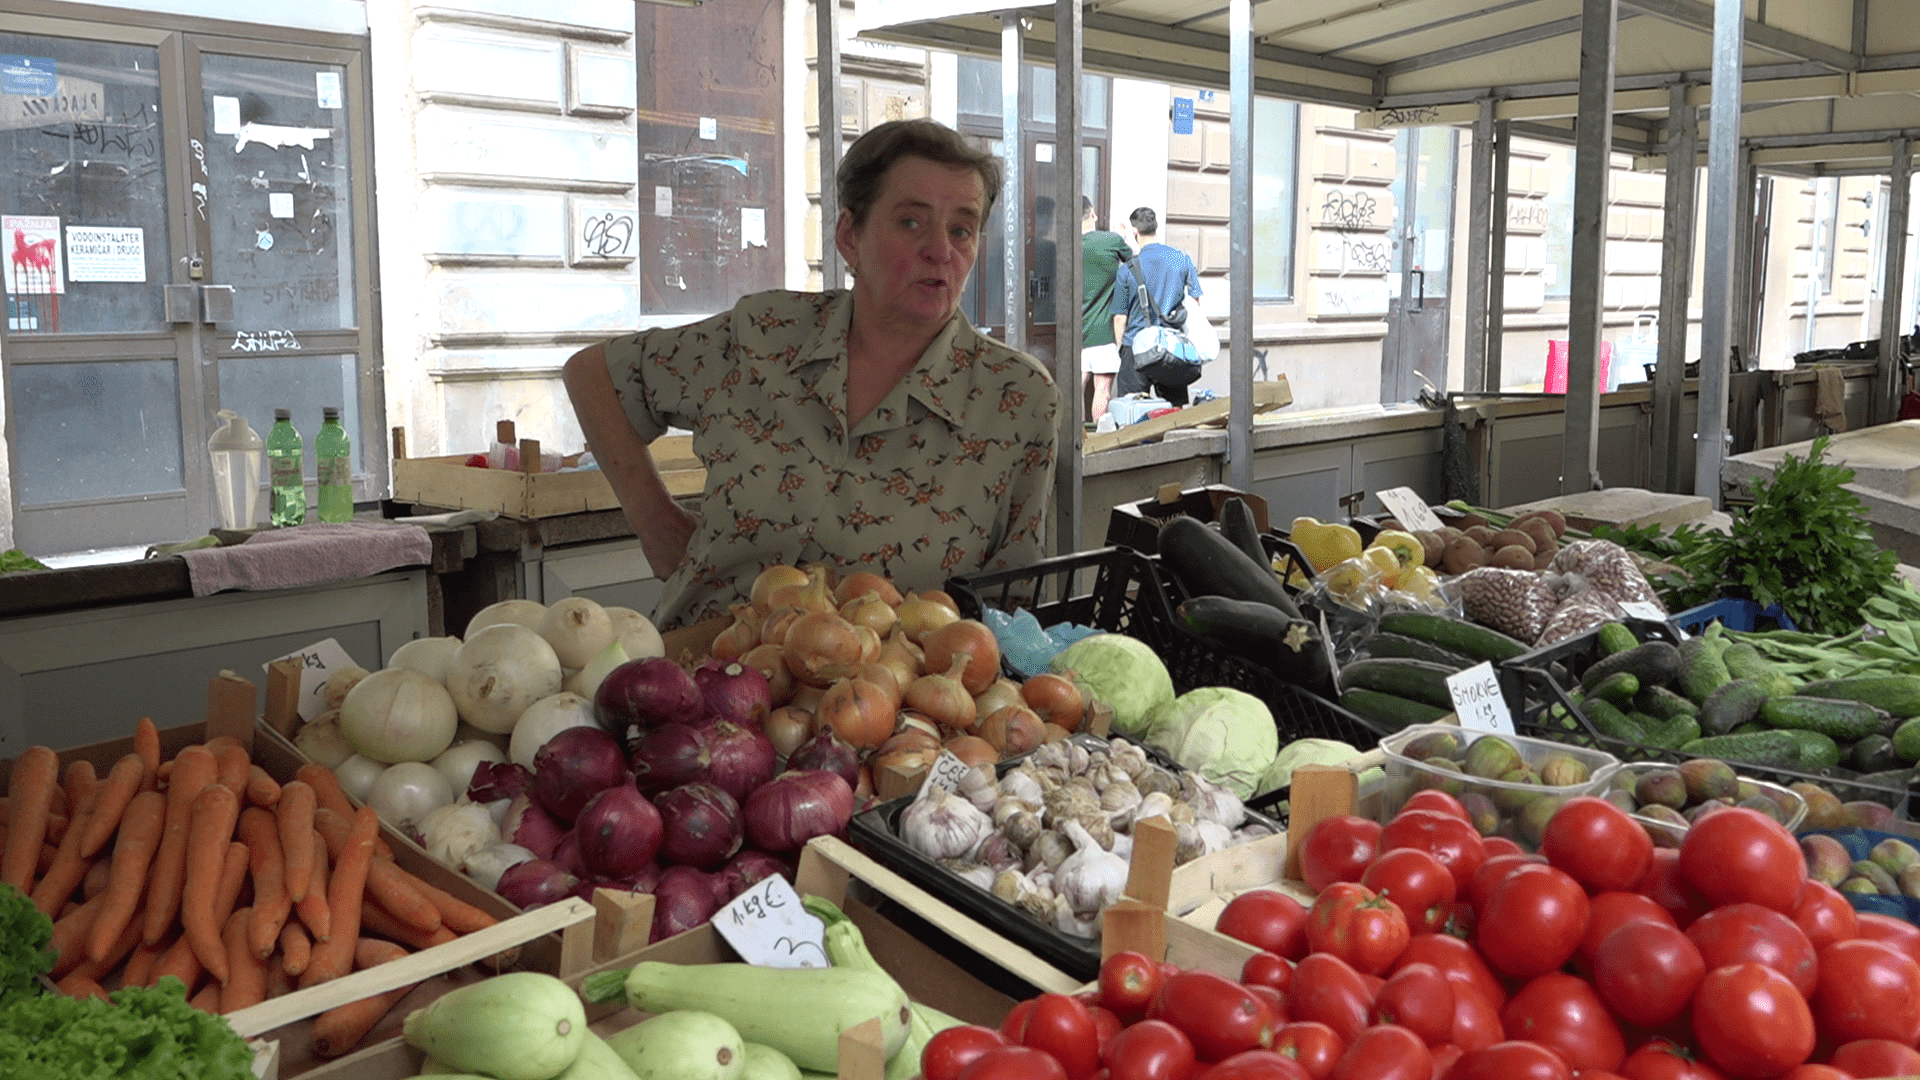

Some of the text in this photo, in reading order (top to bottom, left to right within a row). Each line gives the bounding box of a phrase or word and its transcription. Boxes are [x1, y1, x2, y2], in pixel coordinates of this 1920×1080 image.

[71, 231, 140, 243] VODOINSTALATER
[117, 245, 141, 256] DRUGO
[1452, 678, 1499, 707] SMOKVE
